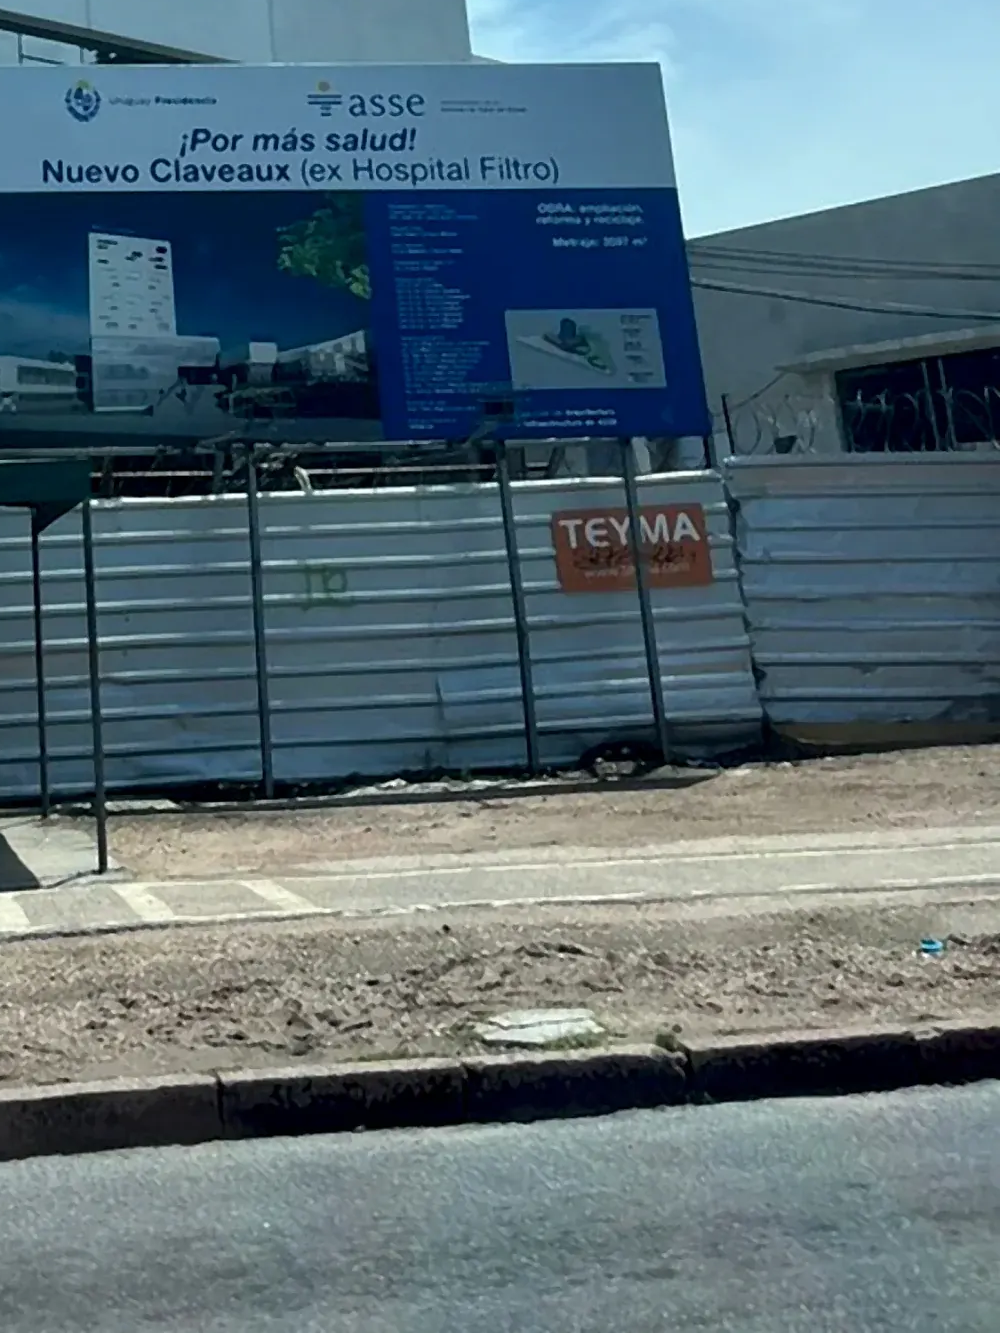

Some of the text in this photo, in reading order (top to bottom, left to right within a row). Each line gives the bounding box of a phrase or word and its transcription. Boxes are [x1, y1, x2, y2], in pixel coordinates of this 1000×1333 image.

[349, 93, 424, 117] asse
[179, 126, 417, 157] ¡Por más salud!
[42, 156, 560, 186] Nuevo Claveaux (ex Hospital Filtro)
[558, 512, 701, 550] TEYMA
